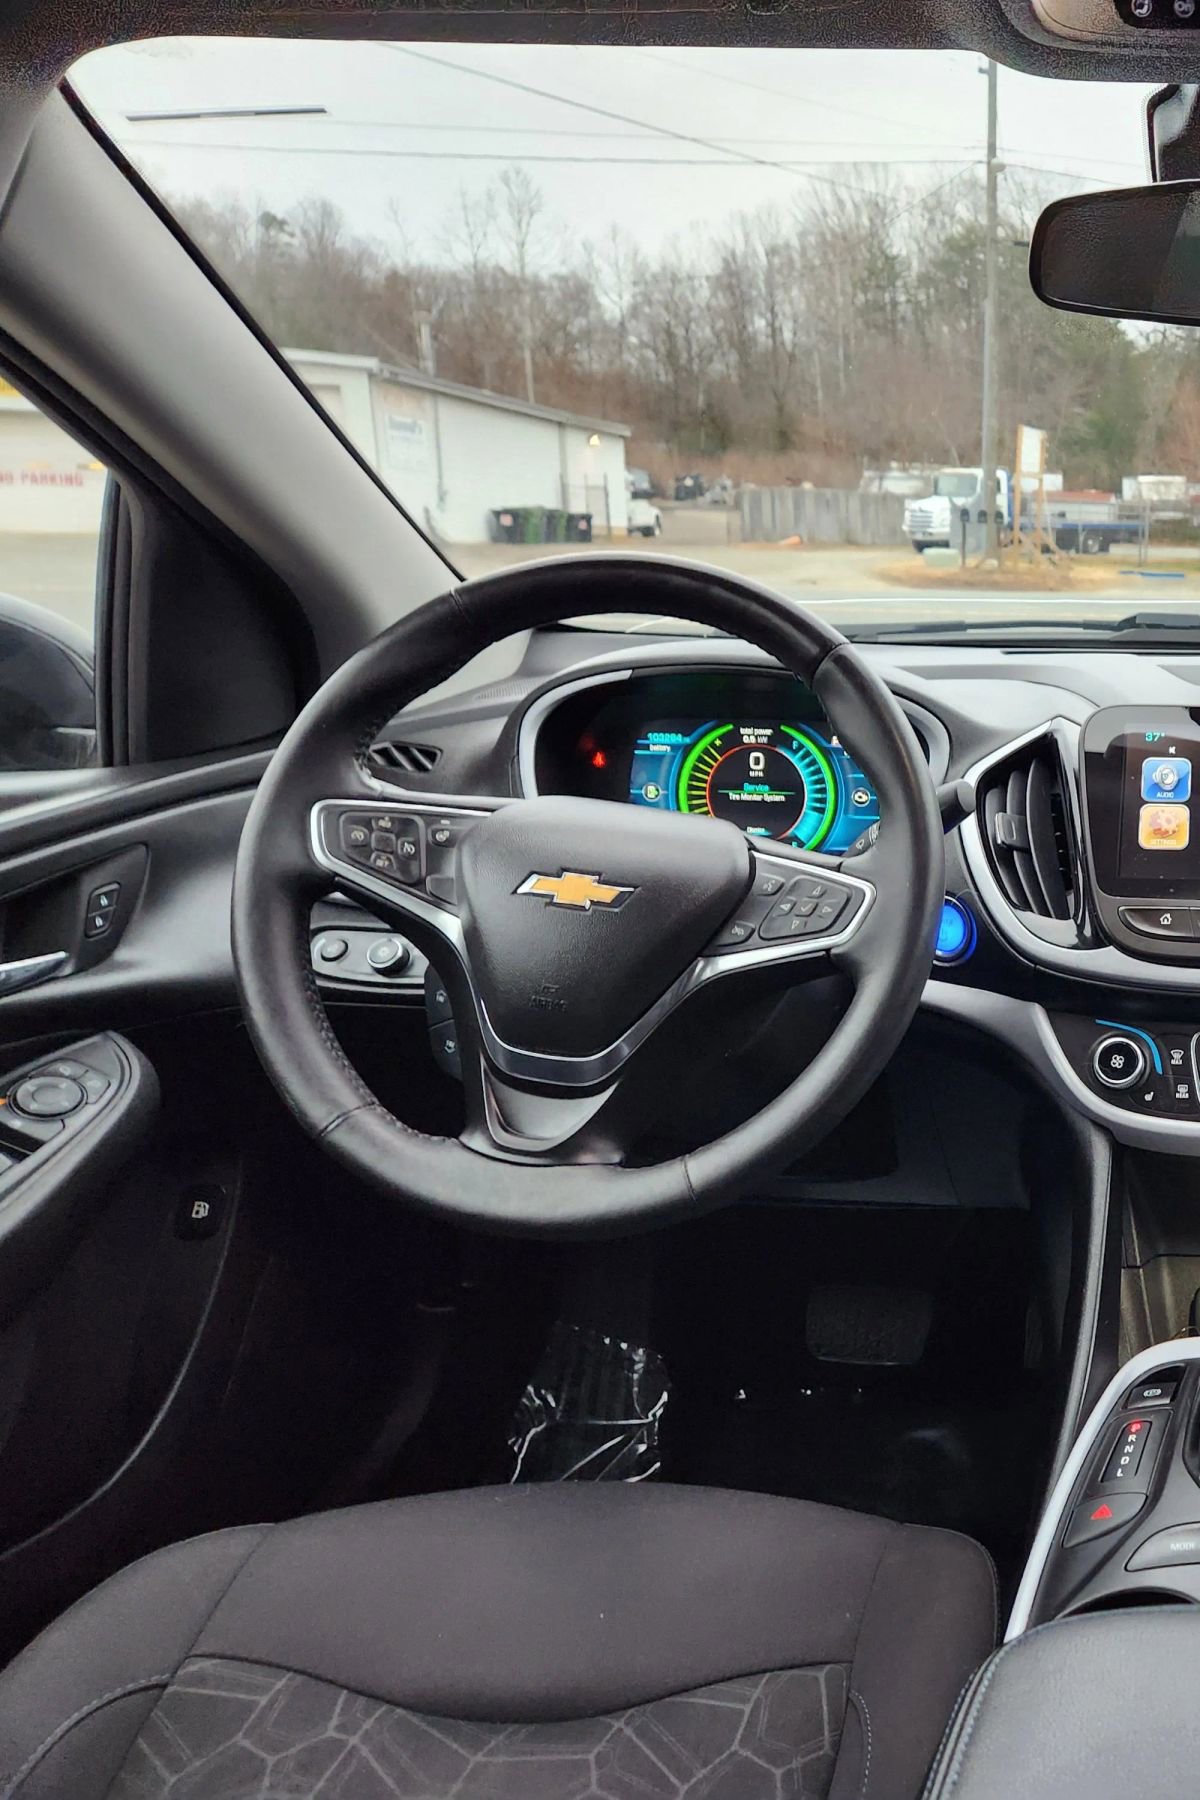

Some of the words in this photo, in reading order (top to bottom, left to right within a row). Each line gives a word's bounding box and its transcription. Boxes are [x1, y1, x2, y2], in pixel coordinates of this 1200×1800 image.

[21, 472, 84, 487] PARKING
[754, 728, 774, 737] power
[749, 751, 766, 771] 0
[749, 770, 764, 778] MPH
[744, 782, 770, 793] Service
[1156, 791, 1175, 799] AUDIO
[1127, 1434, 1137, 1443] R
[1123, 1444, 1134, 1454] N
[1120, 1455, 1130, 1465] D
[1116, 1467, 1124, 1477] L
